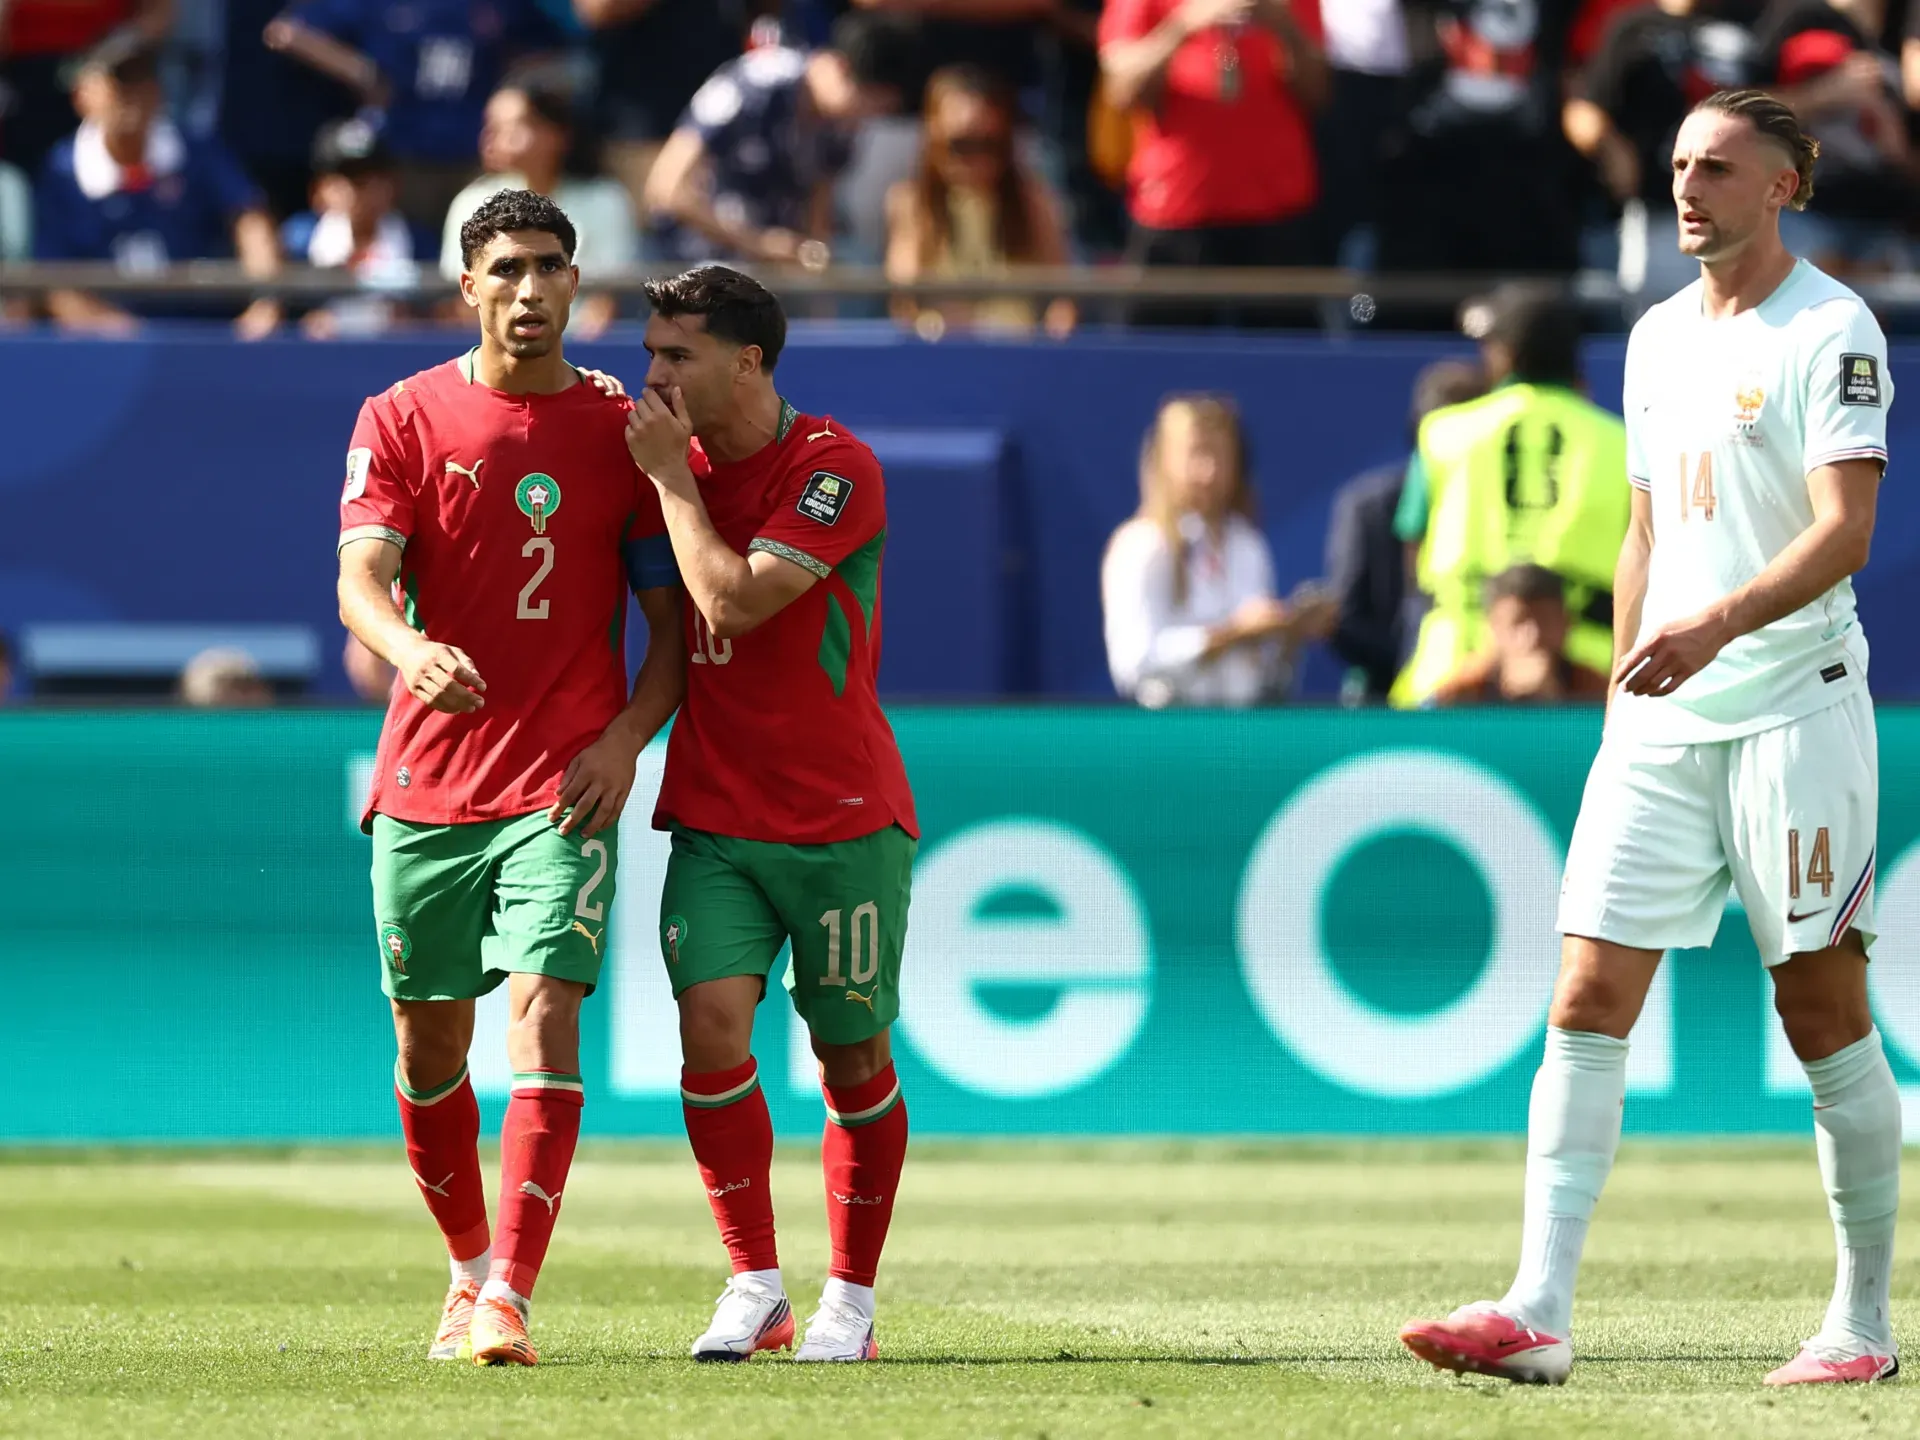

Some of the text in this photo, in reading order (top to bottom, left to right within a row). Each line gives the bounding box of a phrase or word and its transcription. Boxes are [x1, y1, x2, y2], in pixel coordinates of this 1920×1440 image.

[804, 497, 836, 517] EDUCATION
[1680, 451, 1716, 523] 14
[516, 537, 555, 619] 2
[574, 838, 608, 922] 2
[1788, 827, 1834, 899] 14
[818, 900, 879, 987] 10
